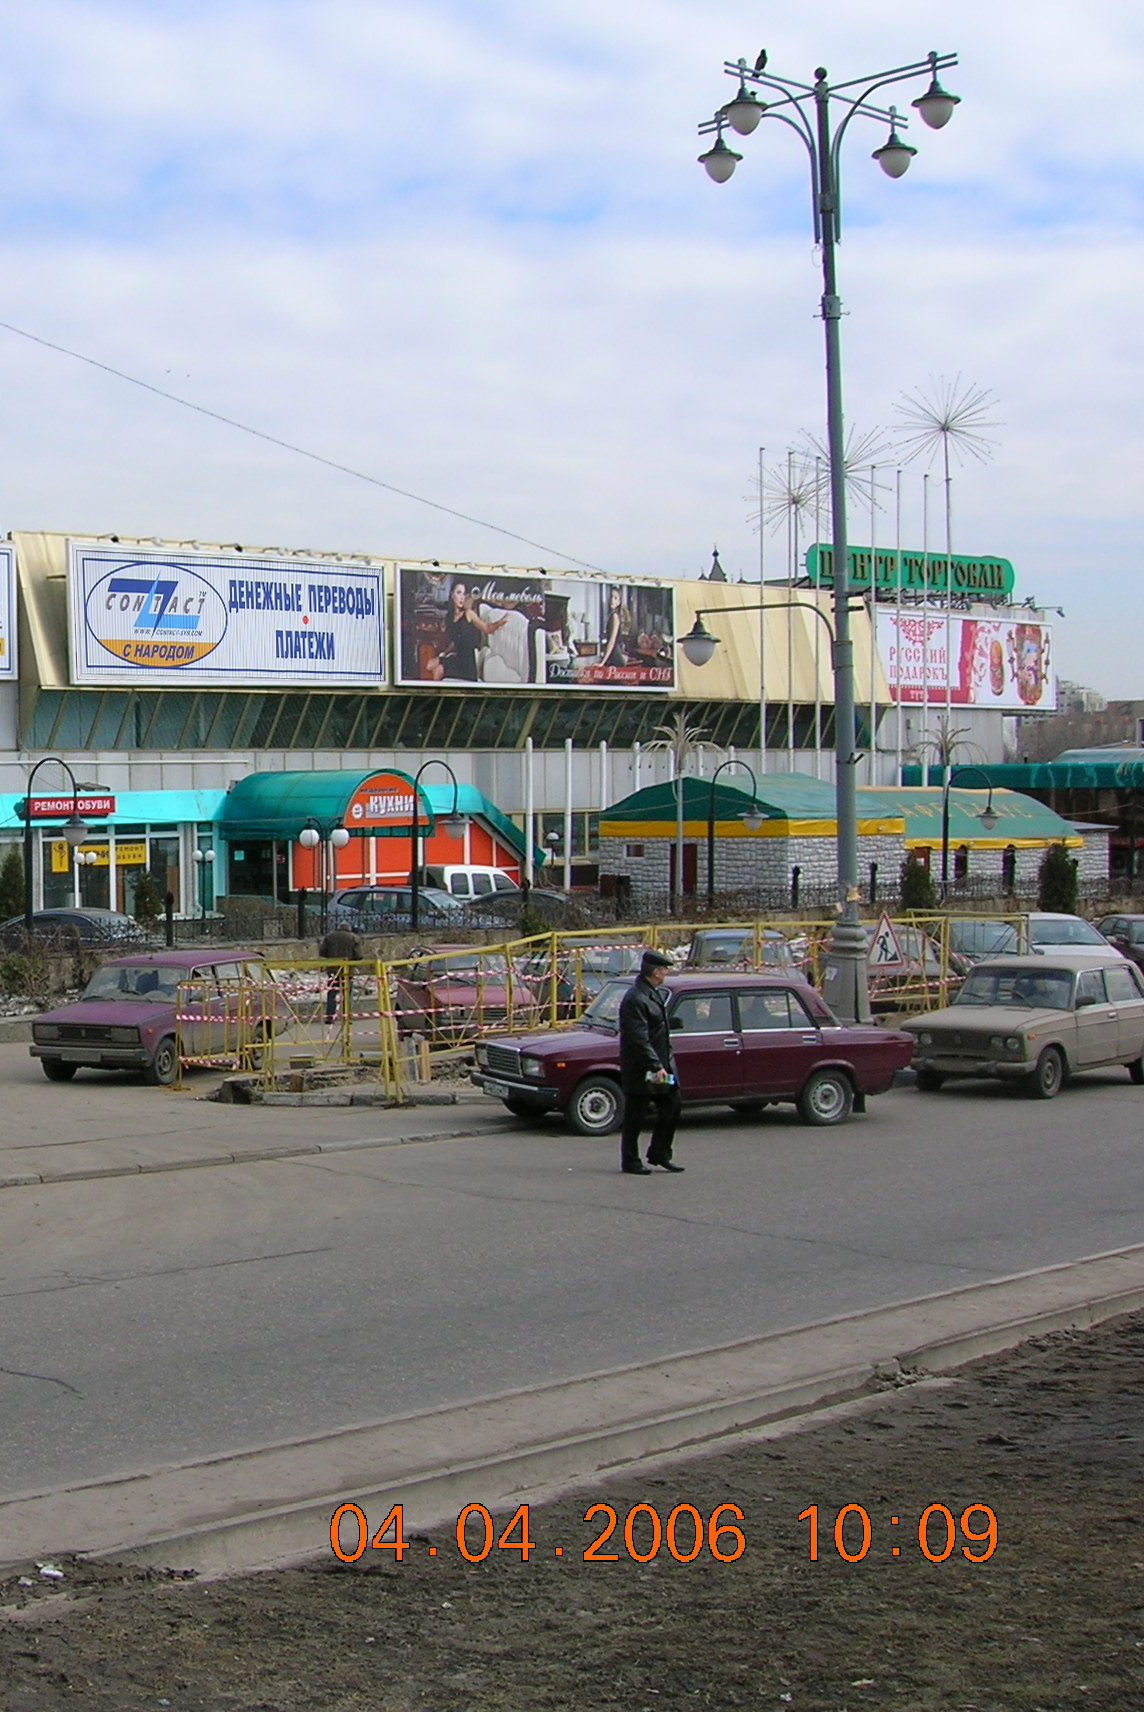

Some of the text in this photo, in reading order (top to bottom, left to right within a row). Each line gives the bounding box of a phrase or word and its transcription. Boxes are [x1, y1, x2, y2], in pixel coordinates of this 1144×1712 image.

[821, 551, 1005, 589] ЦНТР ТОРГОВЛИ
[105, 593, 205, 614] CONTACT
[229, 579, 375, 619] ДЕНЕЖНЫЕ ПЕРЕВОДЫ
[123, 644, 195, 661] С НАРОДОМ
[276, 630, 335, 660] ПЛАТЕЖИ
[889, 646, 946, 664] РССИЙ
[649, 667, 672, 680] СНГ
[34, 799, 111, 811] РЕМОНТ ОБУВИ
[369, 795, 414, 814] КУХНИ
